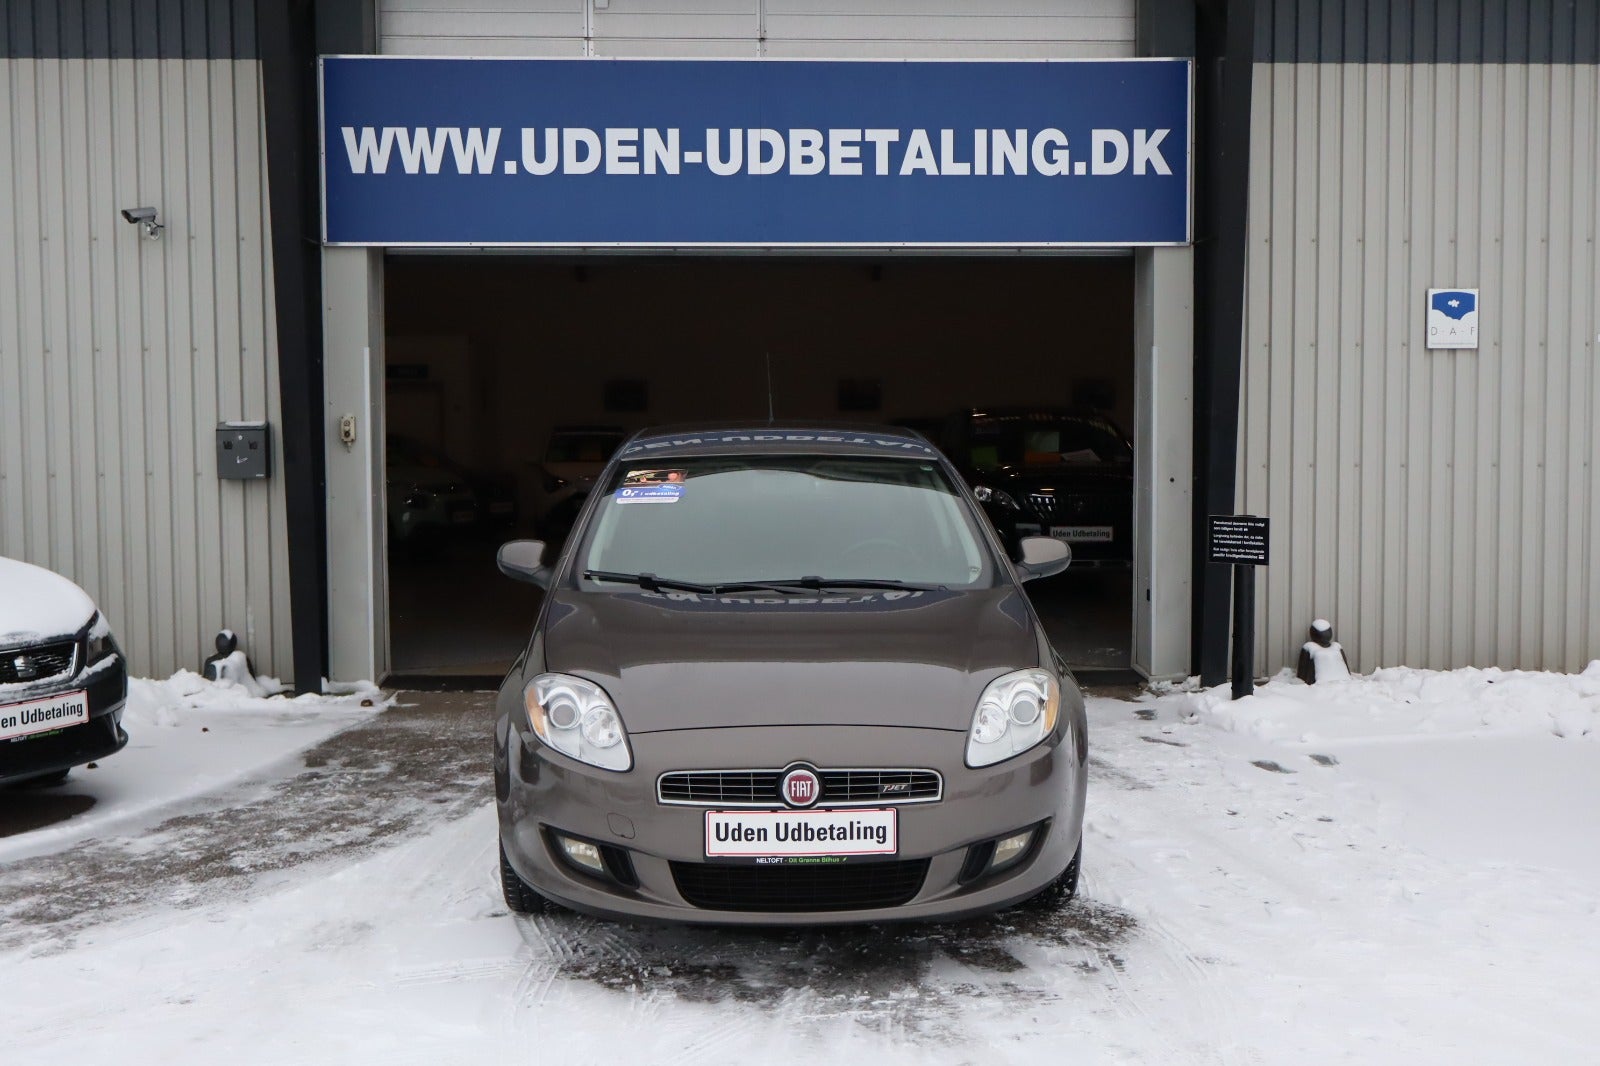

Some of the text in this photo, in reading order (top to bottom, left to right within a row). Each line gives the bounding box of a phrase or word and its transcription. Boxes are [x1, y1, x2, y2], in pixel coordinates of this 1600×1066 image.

[341, 126, 1173, 177] WWW.UDEN-UDBETALING.DK
[1052, 528, 1110, 539] Uden Udbetaling
[0, 702, 84, 729] en Udbetaling
[791, 780, 813, 797] FIAT
[715, 820, 887, 844] Uden Udbetaling
